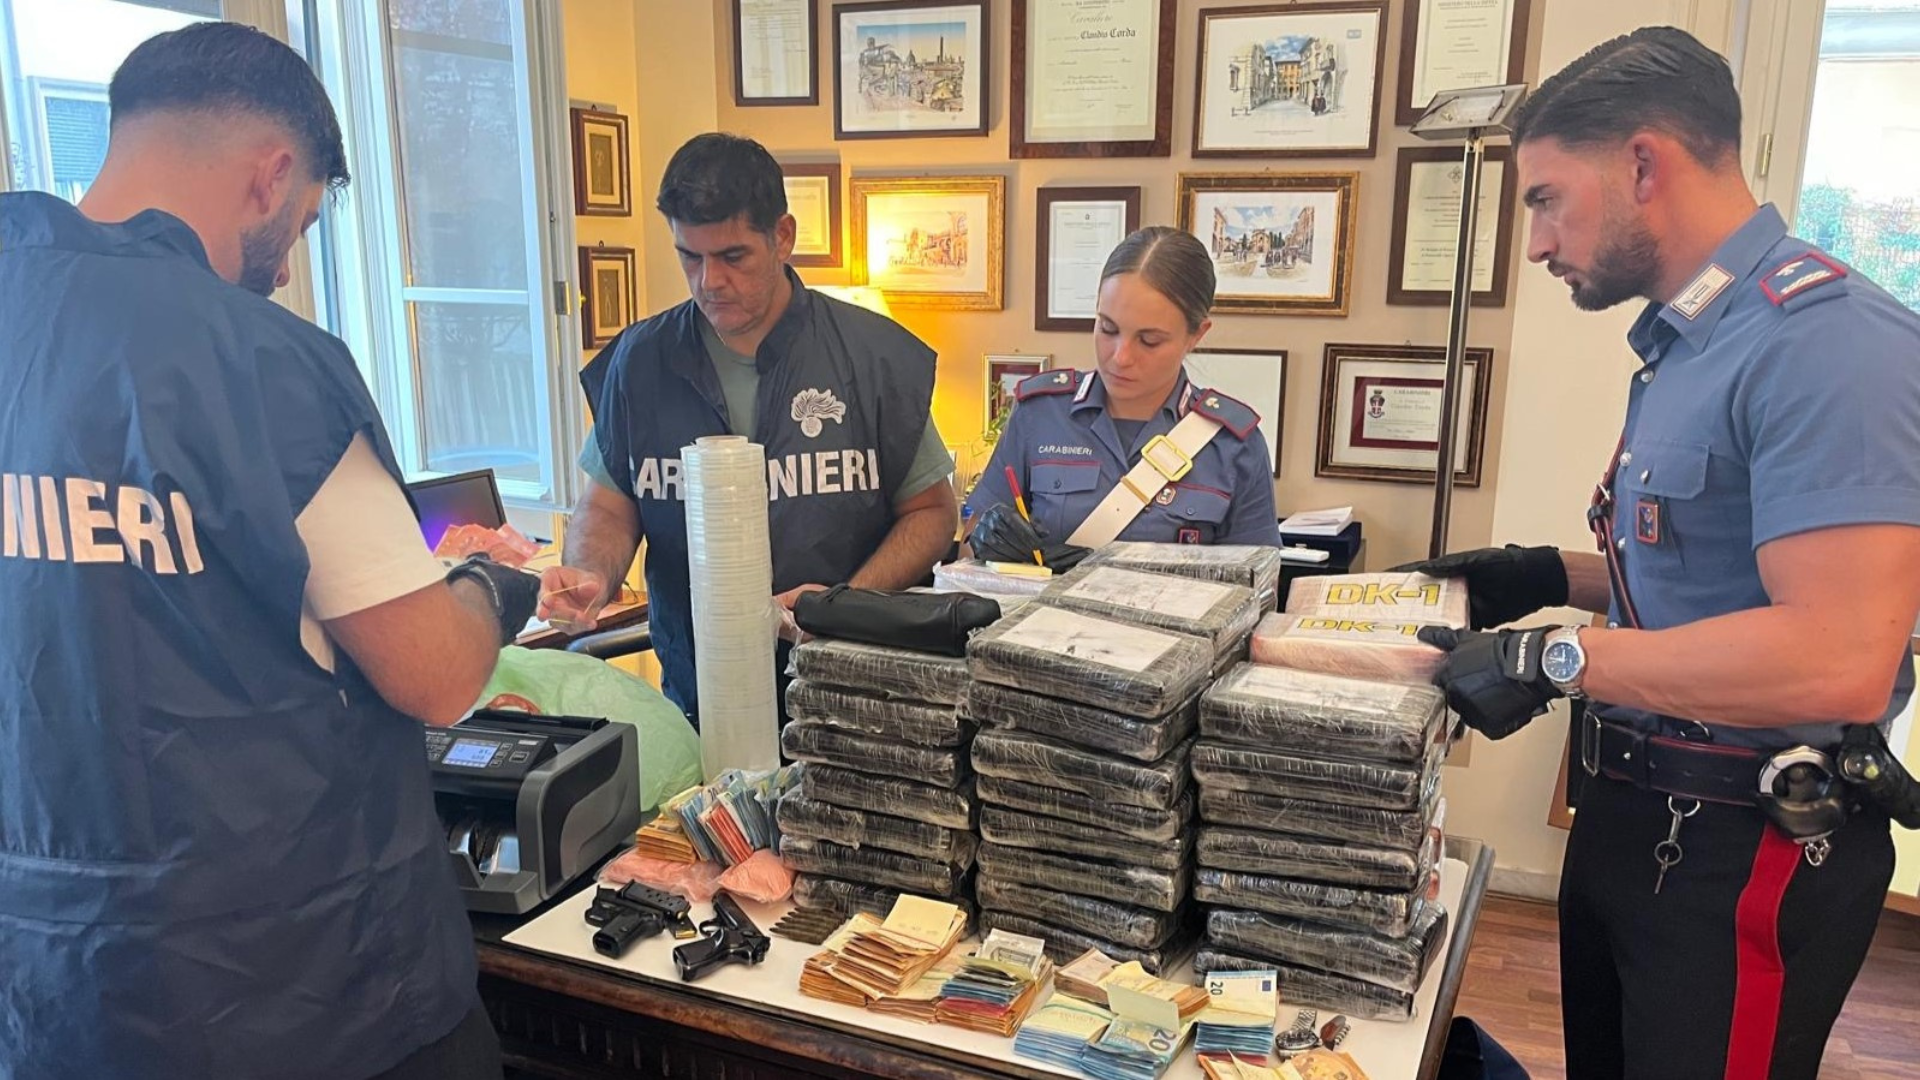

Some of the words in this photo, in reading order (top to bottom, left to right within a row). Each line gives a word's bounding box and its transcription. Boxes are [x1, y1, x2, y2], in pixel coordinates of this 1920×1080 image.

[1109, 27, 1136, 38] Corda
[1038, 445, 1093, 455] CARABINIERI
[1326, 583, 1440, 606] DK-1
[1297, 618, 1418, 636] DK-1
[1210, 981, 1224, 996] 20
[1150, 1028, 1177, 1051] 20
